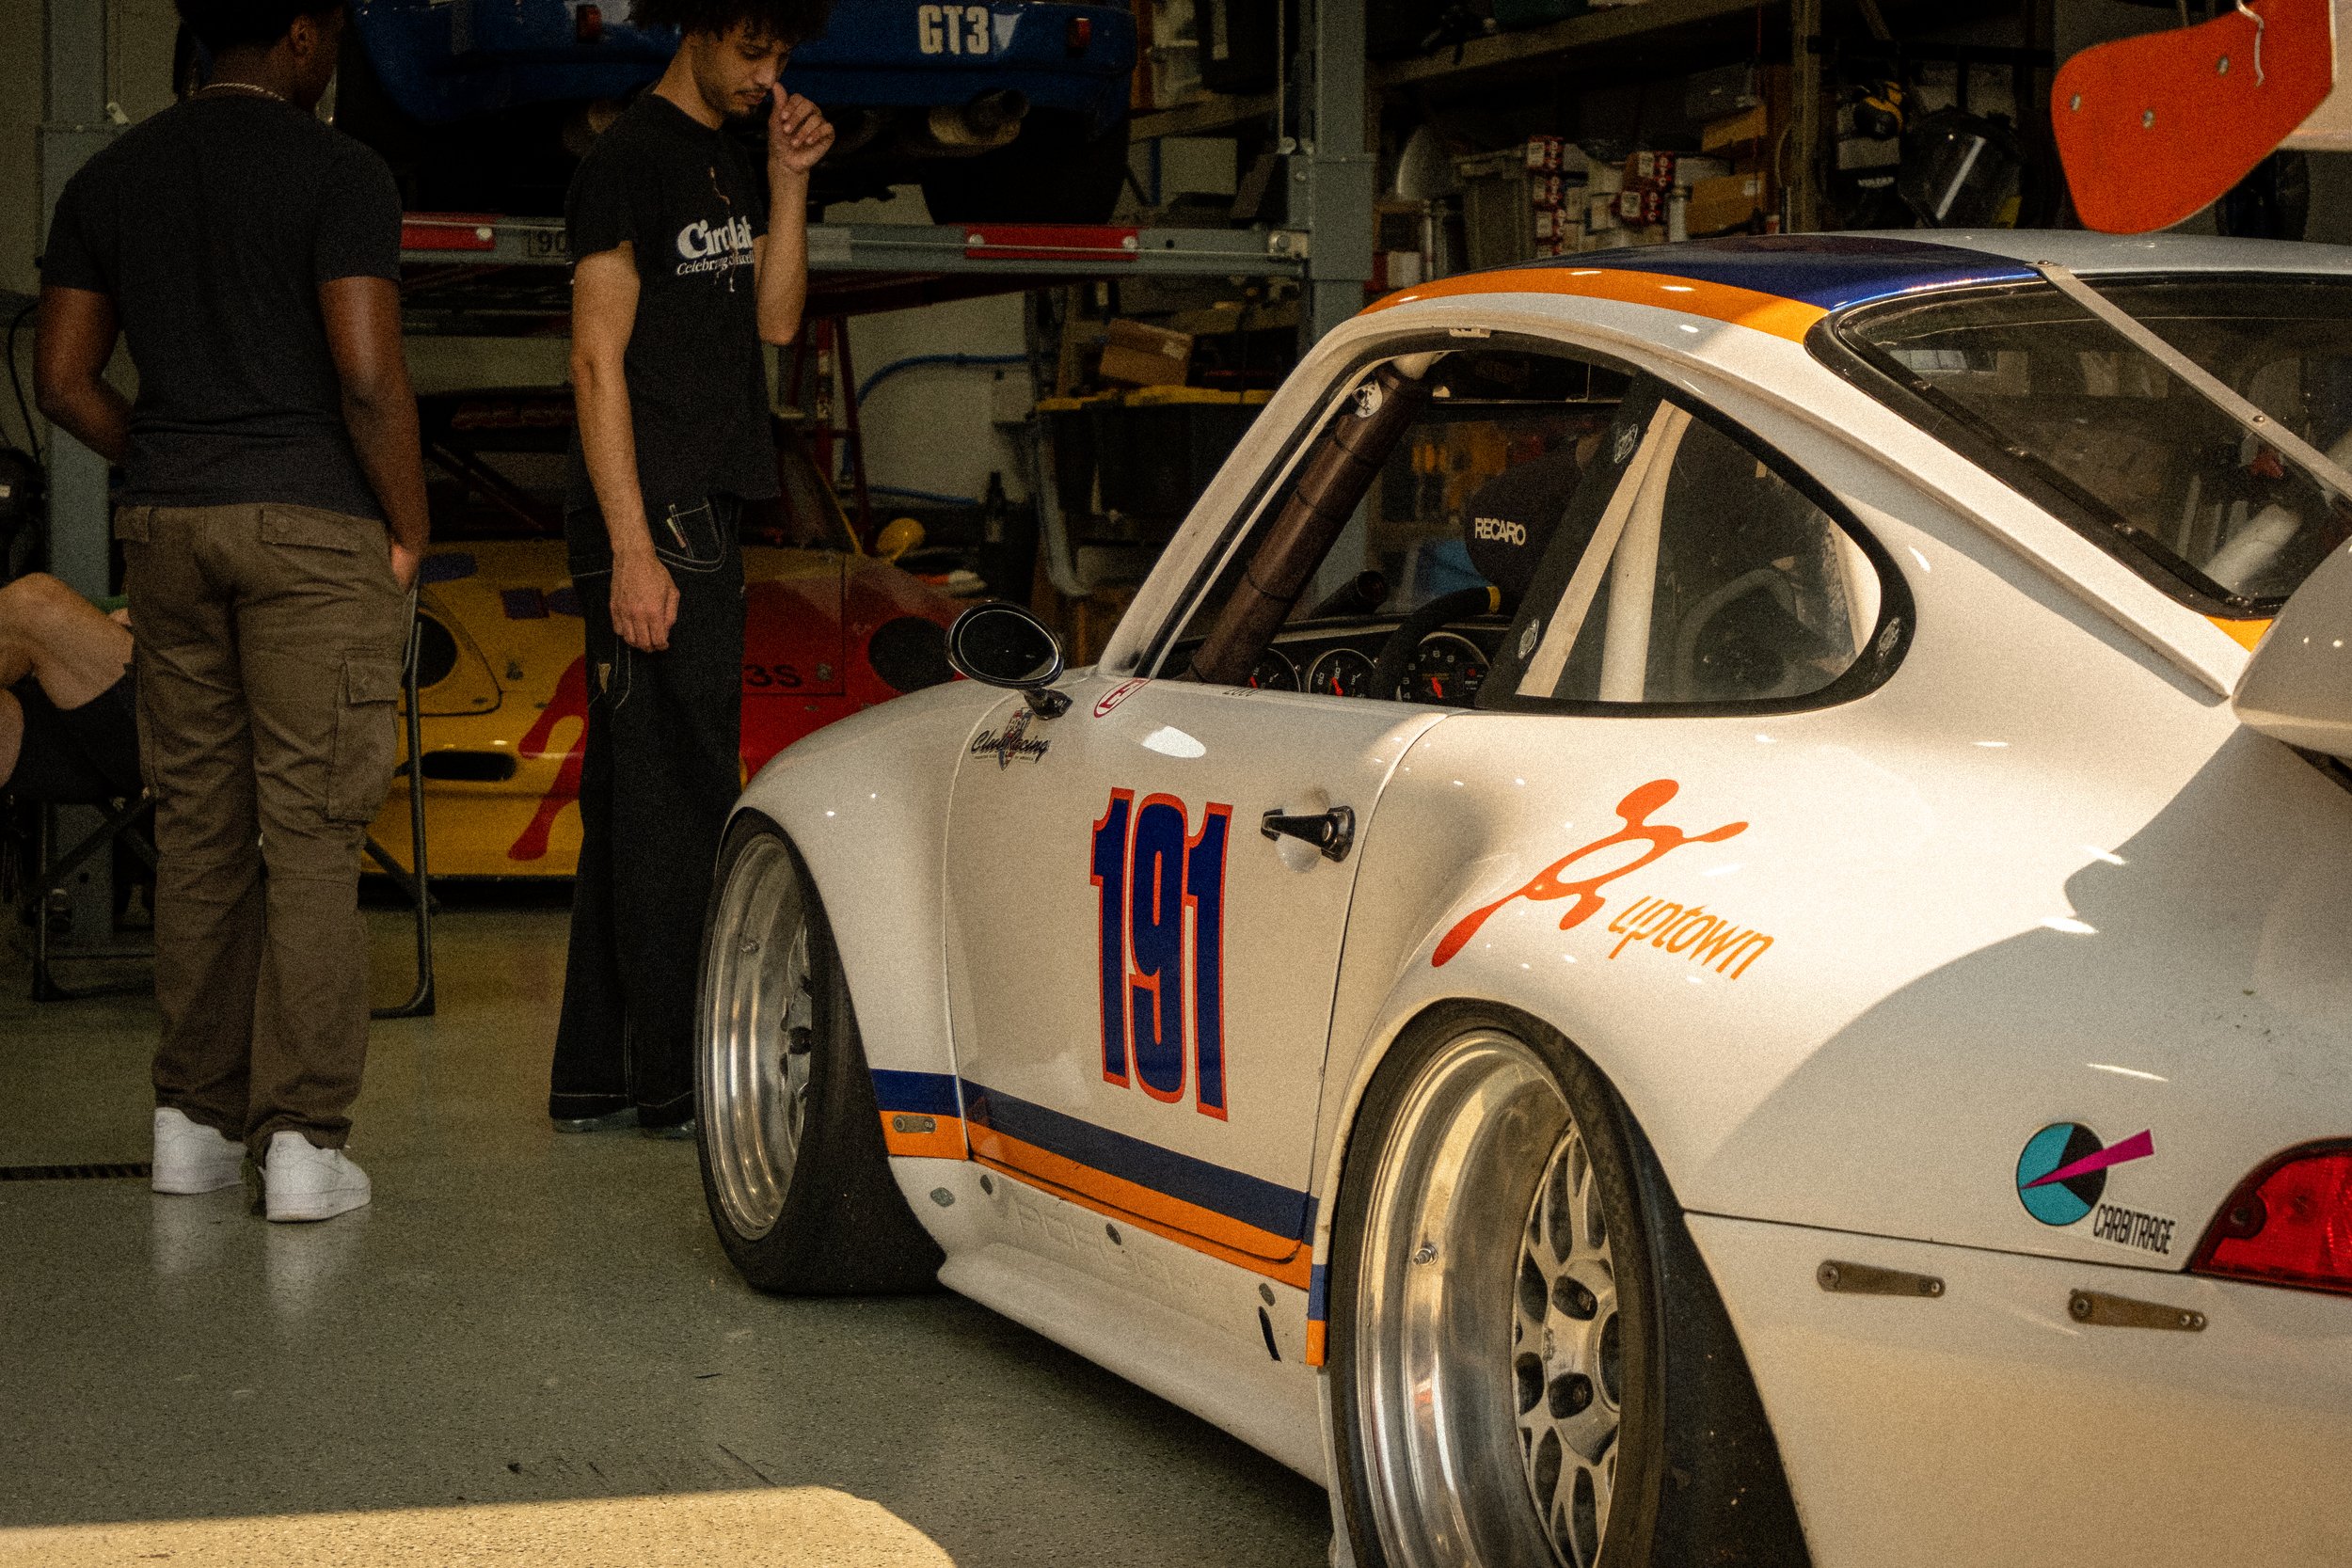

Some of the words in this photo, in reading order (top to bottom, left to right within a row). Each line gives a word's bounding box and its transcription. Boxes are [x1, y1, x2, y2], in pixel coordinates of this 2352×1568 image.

[917, 4, 990, 55] GT3
[1474, 516, 1526, 546] RECARO
[1089, 786, 1233, 1122] 191
[1608, 895, 1774, 980] uptown
[2093, 1204, 2175, 1255] CARBITRAGE
